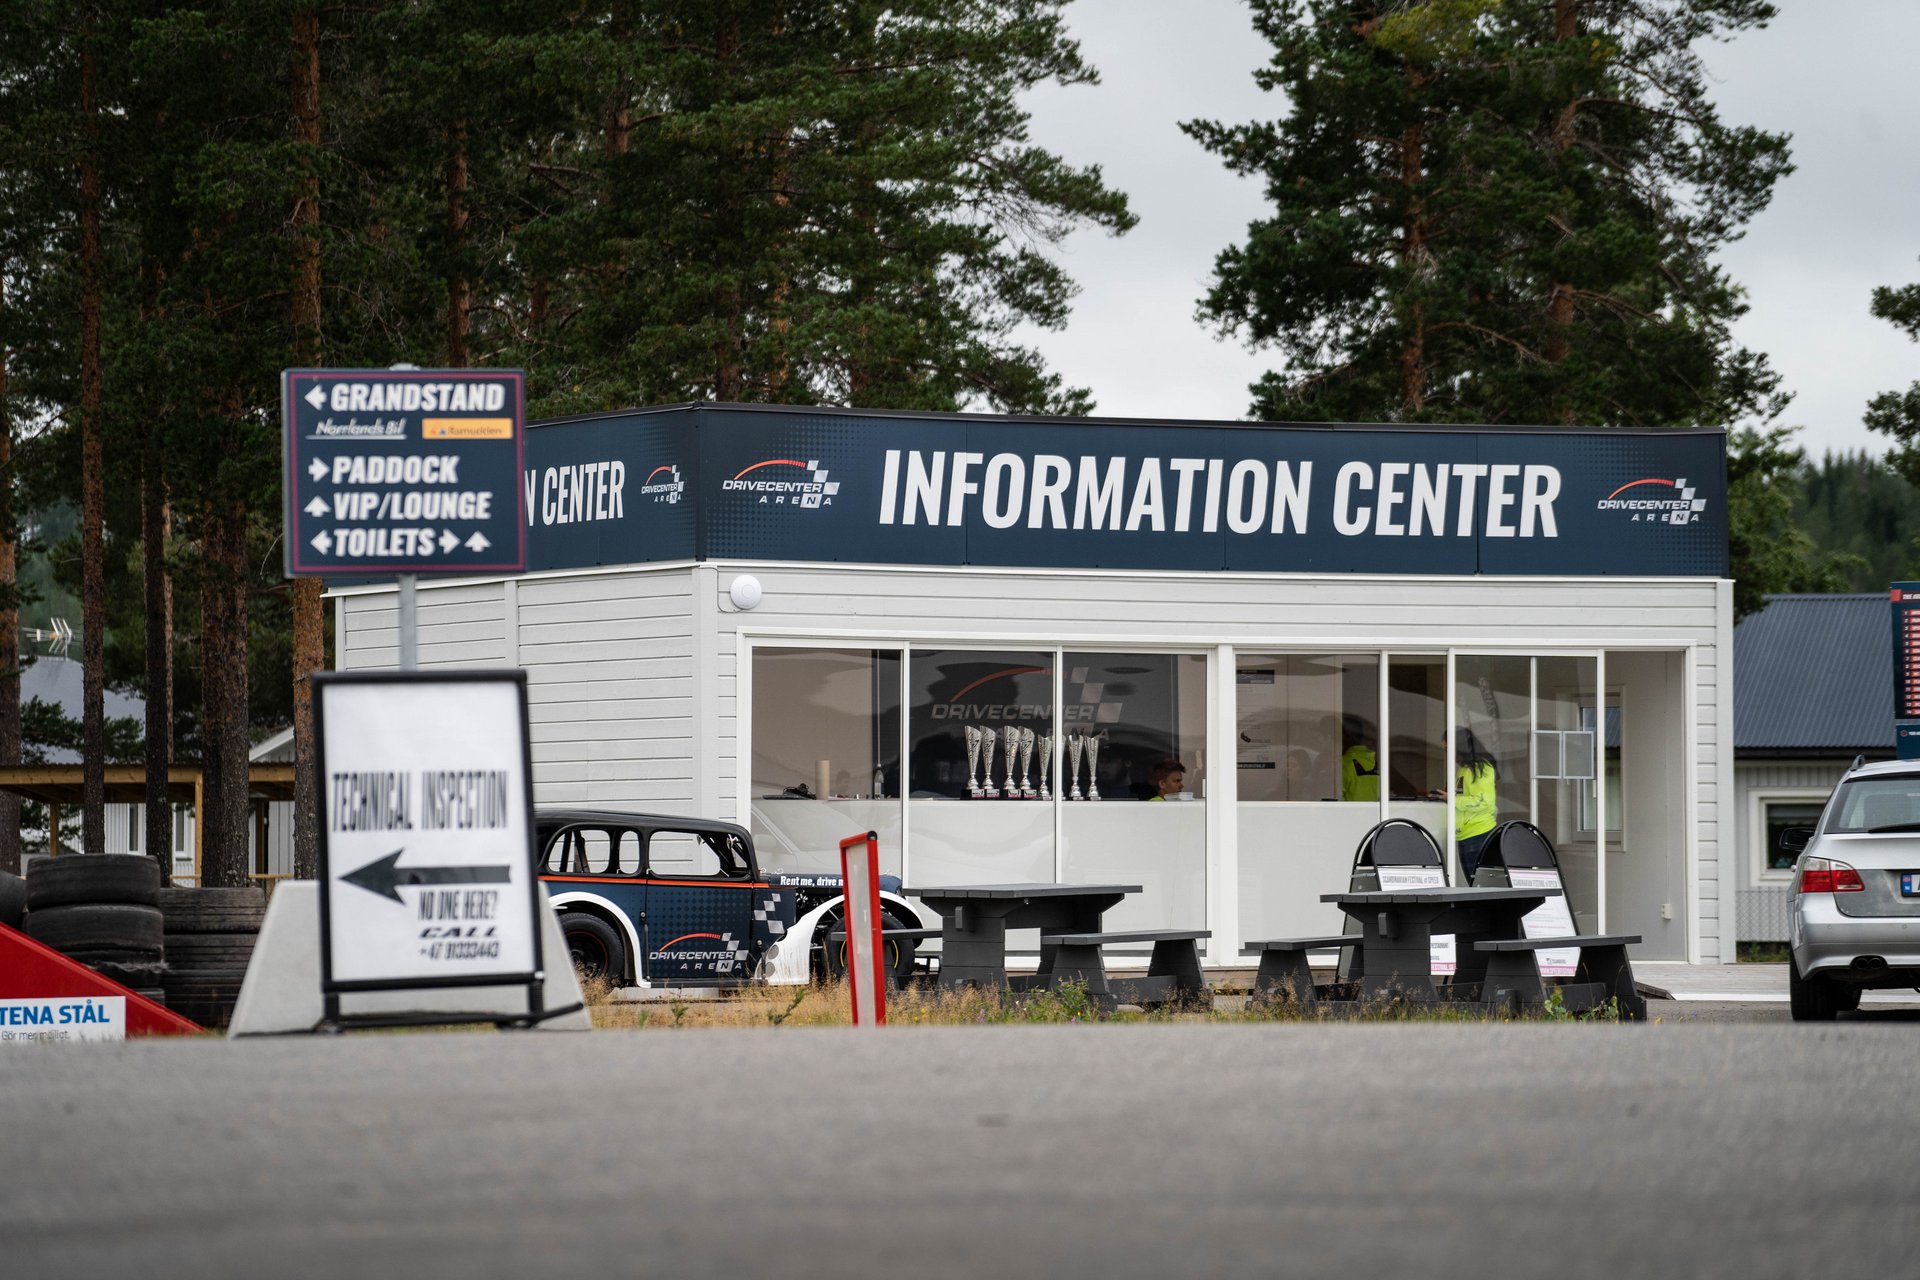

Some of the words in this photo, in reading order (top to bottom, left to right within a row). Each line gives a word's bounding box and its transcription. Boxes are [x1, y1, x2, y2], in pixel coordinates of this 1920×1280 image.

[330, 383, 505, 412] GRANDSTAND
[315, 418, 385, 436] Norrlands
[386, 418, 407, 435] Bil
[332, 456, 460, 484] PADDOCK
[542, 460, 625, 526] CENTER
[641, 483, 678, 494] DRIVECENTER
[722, 480, 823, 493] DRIVECENTER
[654, 493, 681, 503] ARENA
[758, 495, 832, 506] ARENA
[879, 450, 1313, 534] INFORMATION
[1333, 461, 1561, 538] CENTER
[333, 491, 493, 520] VIP/LOUNGE
[1597, 500, 1691, 510] DRIVECENTER
[1631, 513, 1700, 522] ARENA
[334, 527, 436, 557] TOILETS
[931, 704, 1094, 720] DRIVECENER
[332, 772, 413, 832] TECHNICAL
[421, 771, 508, 830] INSPECTION
[780, 875, 799, 886] Rent
[800, 878, 815, 887] me,
[816, 876, 837, 886] drive
[418, 891, 434, 920] NO
[438, 890, 460, 920] ONE
[463, 890, 498, 919] HERE?
[419, 927, 496, 938] CALL
[649, 951, 734, 960] DRIVECENTER
[680, 962, 742, 970] ARENA
[59, 999, 110, 1024] STÅL
[1, 1030, 16, 1040] Gör
